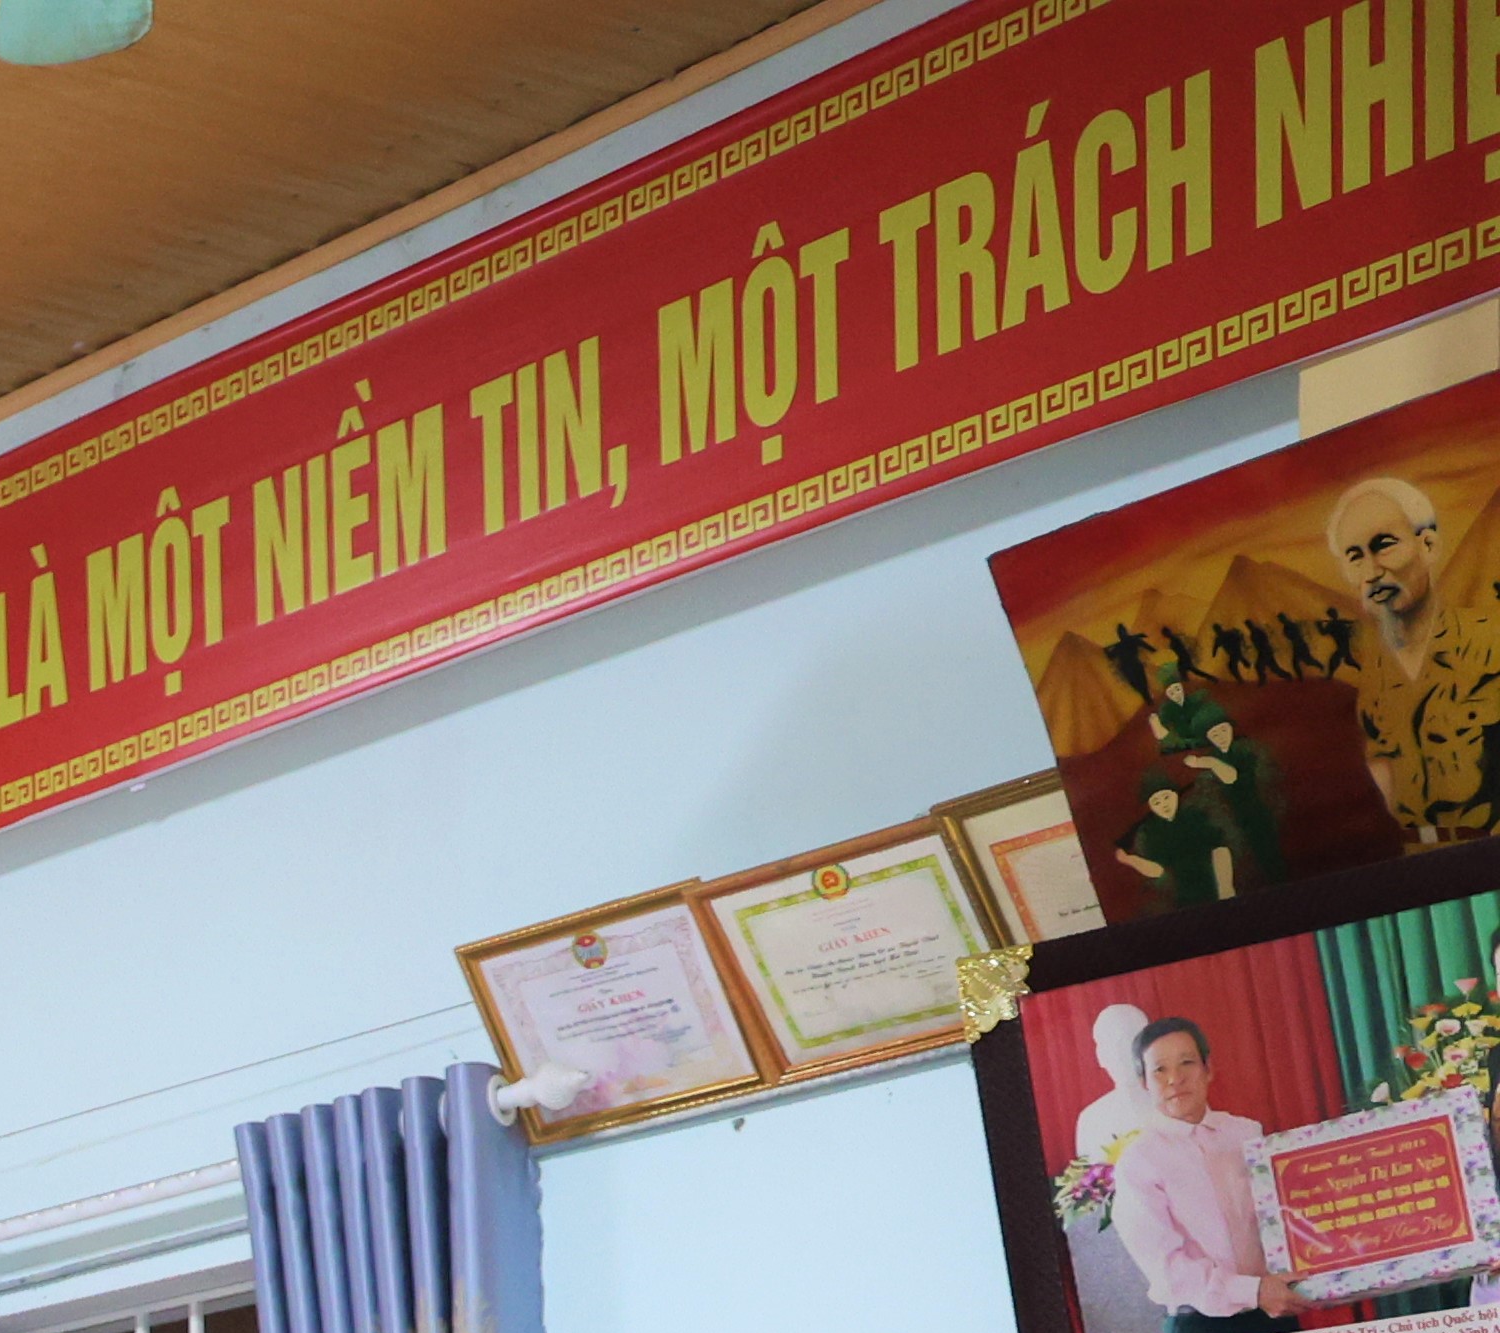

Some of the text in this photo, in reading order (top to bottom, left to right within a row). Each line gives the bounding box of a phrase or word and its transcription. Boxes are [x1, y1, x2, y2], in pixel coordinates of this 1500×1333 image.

[85, 487, 231, 697] MỘT
[253, 378, 447, 627] NIỀM
[470, 335, 628, 537] TIN,
[657, 220, 850, 466] MỘT
[878, 69, 1212, 374] TRÁCH
[1388, 1320, 1414, 1333] Chủ
[1416, 1317, 1440, 1331] tịch
[1443, 1311, 1476, 1327] Quốc
